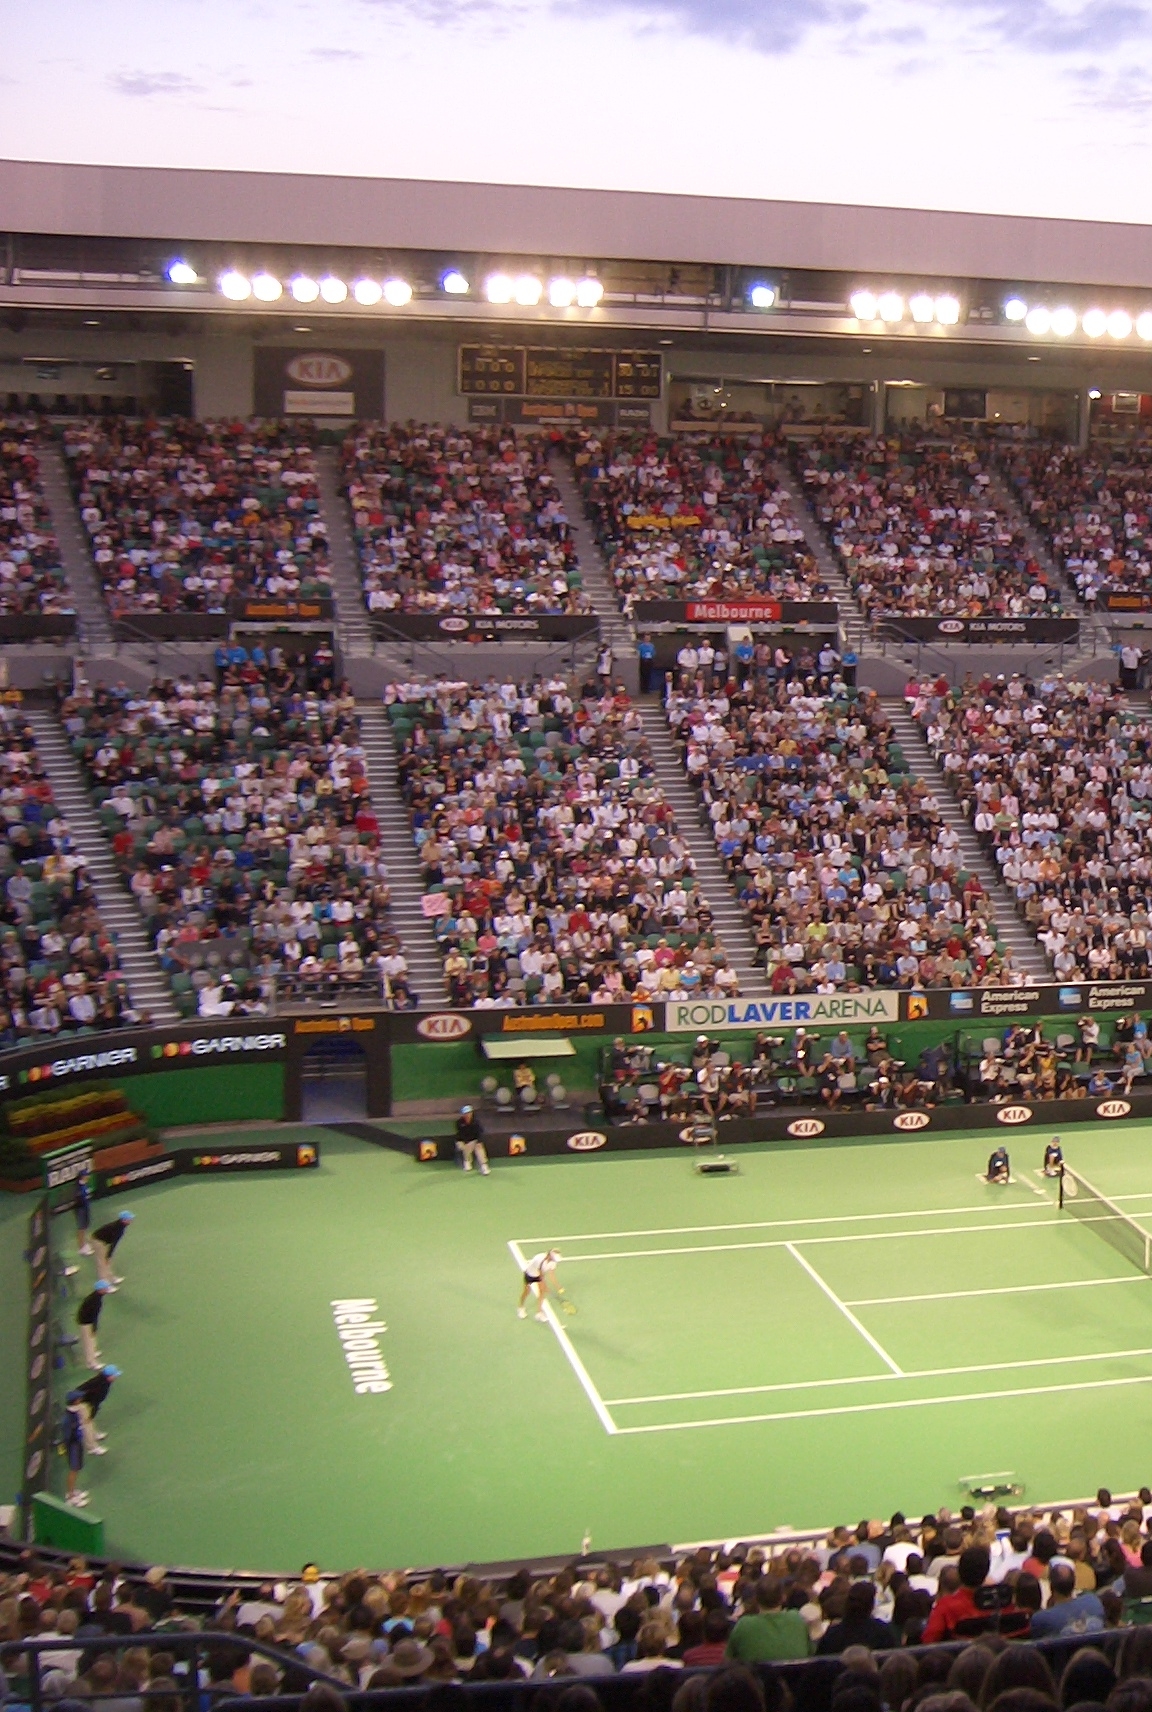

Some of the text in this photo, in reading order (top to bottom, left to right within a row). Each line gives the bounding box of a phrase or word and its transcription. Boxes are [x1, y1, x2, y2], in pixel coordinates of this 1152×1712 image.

[299, 361, 341, 378] KIA
[694, 603, 773, 618] Melbourne
[981, 990, 1040, 1002] American
[1089, 985, 1146, 998] American
[981, 1002, 1029, 1015] Express
[1088, 998, 1135, 1011] Express
[427, 1019, 464, 1033] KIA
[191, 1033, 287, 1055] GARNIER
[52, 1047, 138, 1077] GARNIER
[329, 1298, 394, 1394] Melbourne
